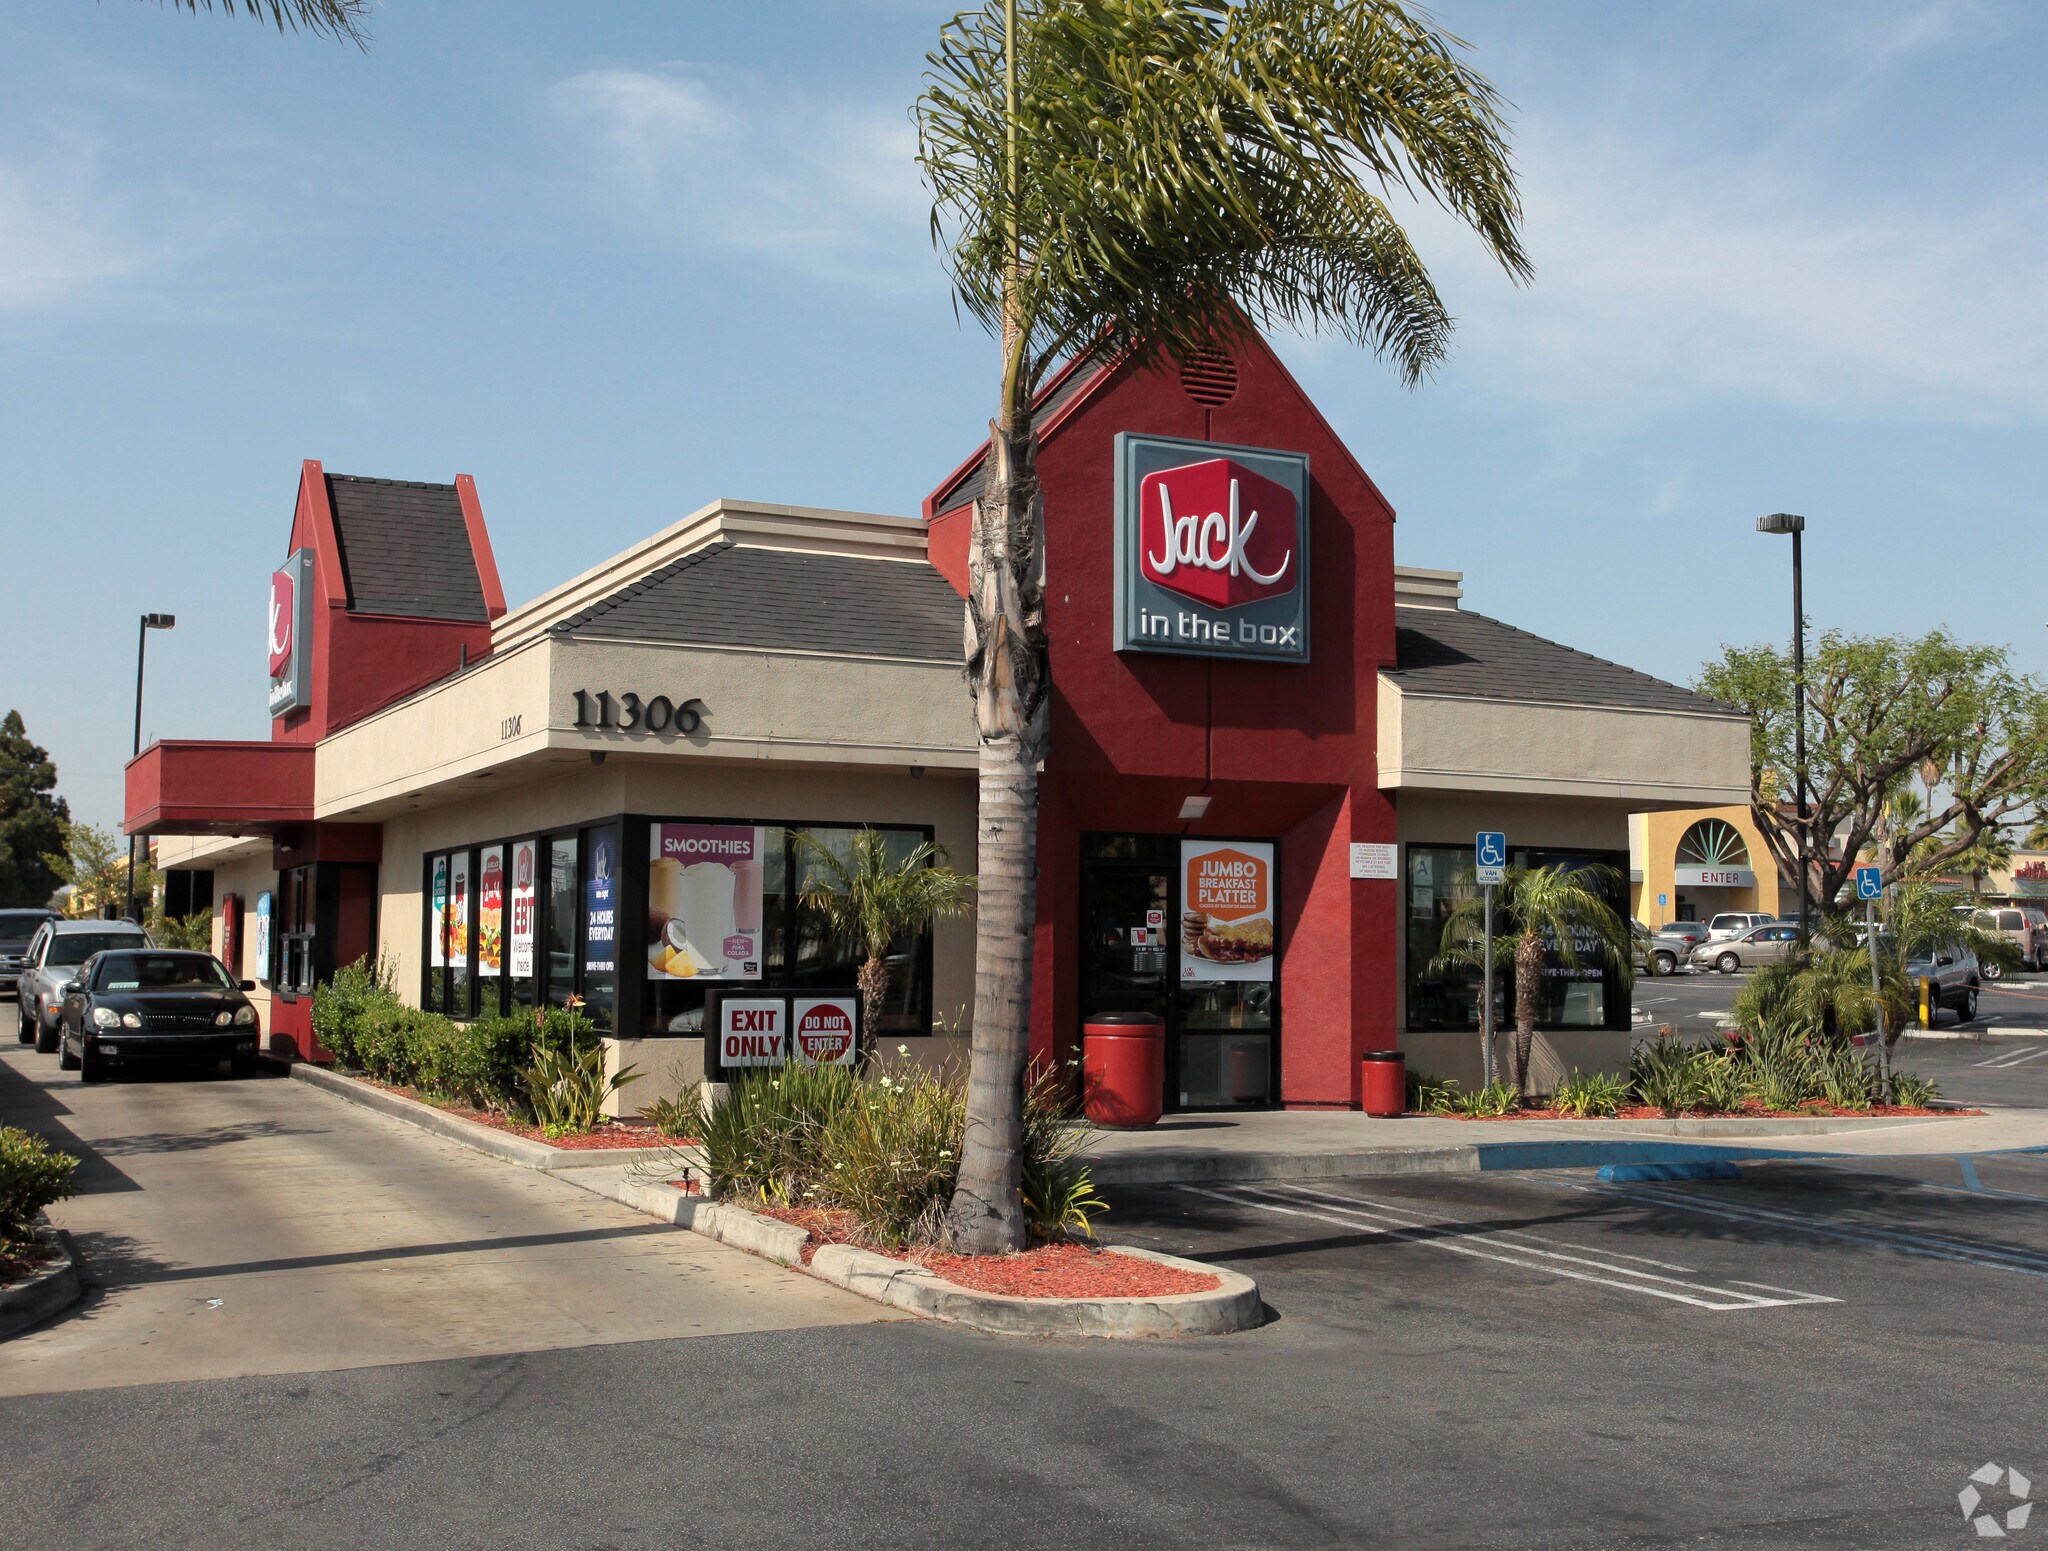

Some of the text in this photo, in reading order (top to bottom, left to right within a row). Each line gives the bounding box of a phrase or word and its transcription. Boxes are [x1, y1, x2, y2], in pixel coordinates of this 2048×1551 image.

[1148, 478, 1290, 585] Jack
[1141, 608, 1296, 646] in the box
[572, 688, 702, 733] 11306
[501, 714, 522, 740] 11306
[664, 838, 750, 855] SMOOTHIES
[1200, 861, 1257, 878] JUMBO
[1418, 860, 1428, 876] A
[1200, 878, 1256, 889] BREAKFAST
[1702, 872, 1738, 883] ENTER
[1199, 889, 1256, 903] PLATTER
[515, 896, 534, 934] EBT
[590, 910, 614, 924] 24 HOURS
[589, 926, 614, 941] EVERYDAY
[514, 938, 533, 953] Welcome
[516, 958, 529, 972] Inside
[732, 1010, 777, 1031] EXIT
[805, 1016, 846, 1029] DO NOT
[726, 1036, 781, 1057] ONLY
[808, 1037, 842, 1051] ENTER
